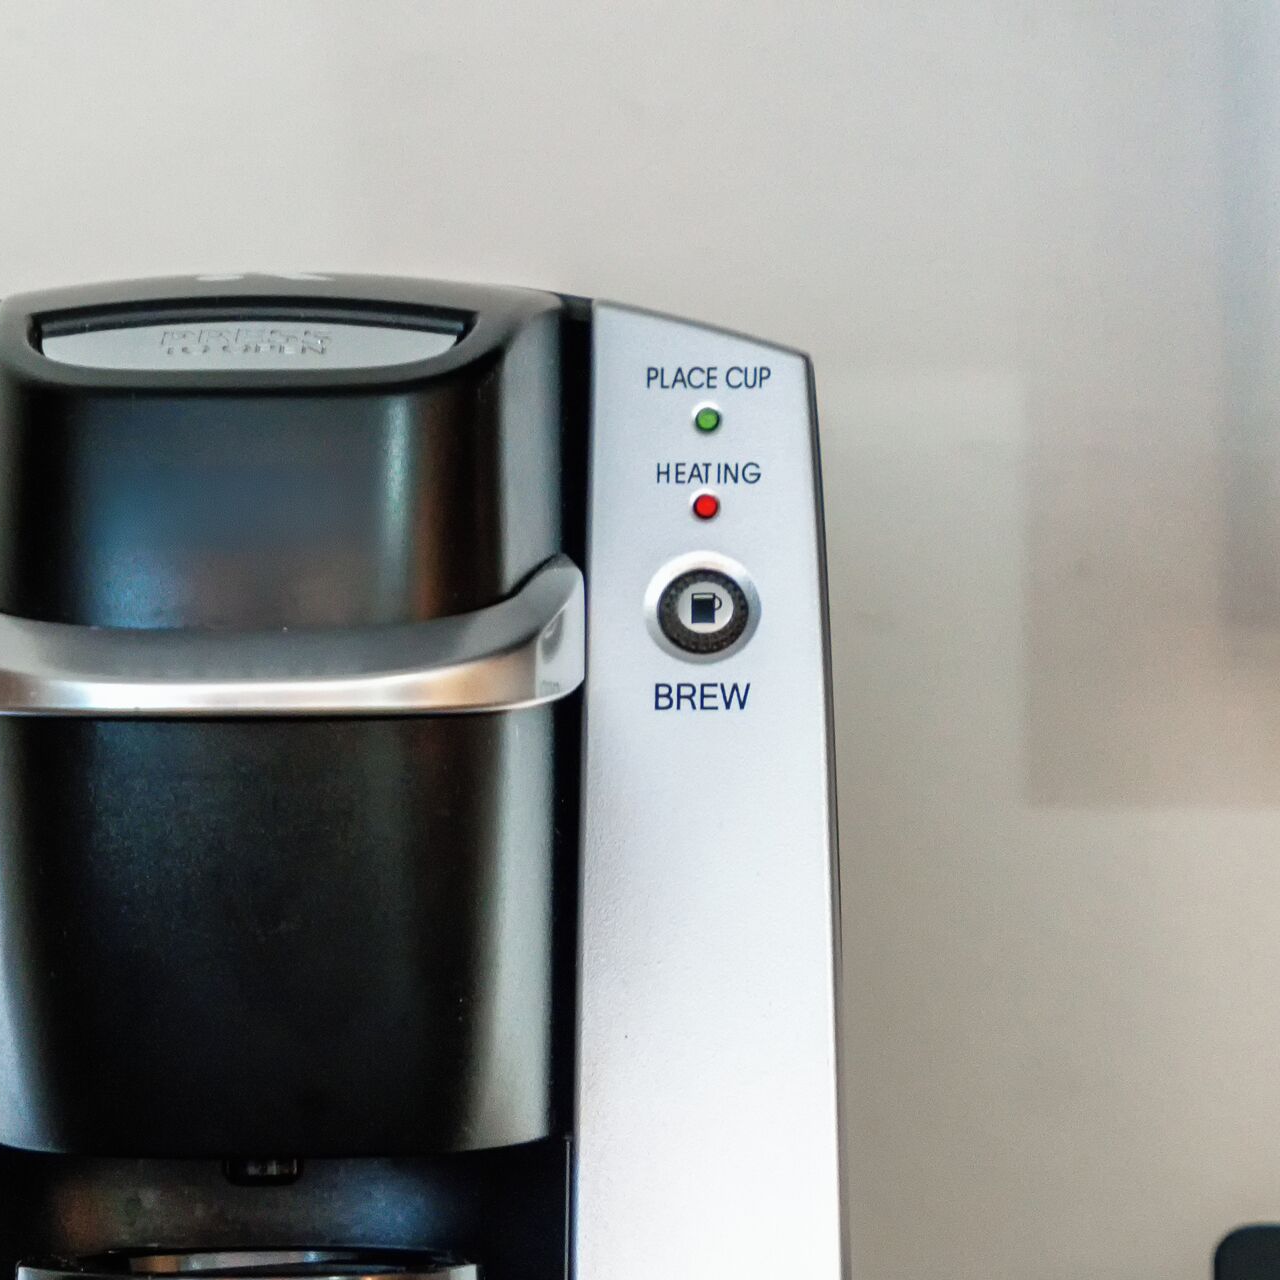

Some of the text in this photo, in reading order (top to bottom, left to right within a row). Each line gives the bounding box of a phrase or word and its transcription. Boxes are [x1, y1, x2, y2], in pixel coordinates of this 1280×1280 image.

[646, 366, 771, 389] PLACE CUP
[656, 462, 762, 485] HEATING
[654, 682, 751, 711] BREW
